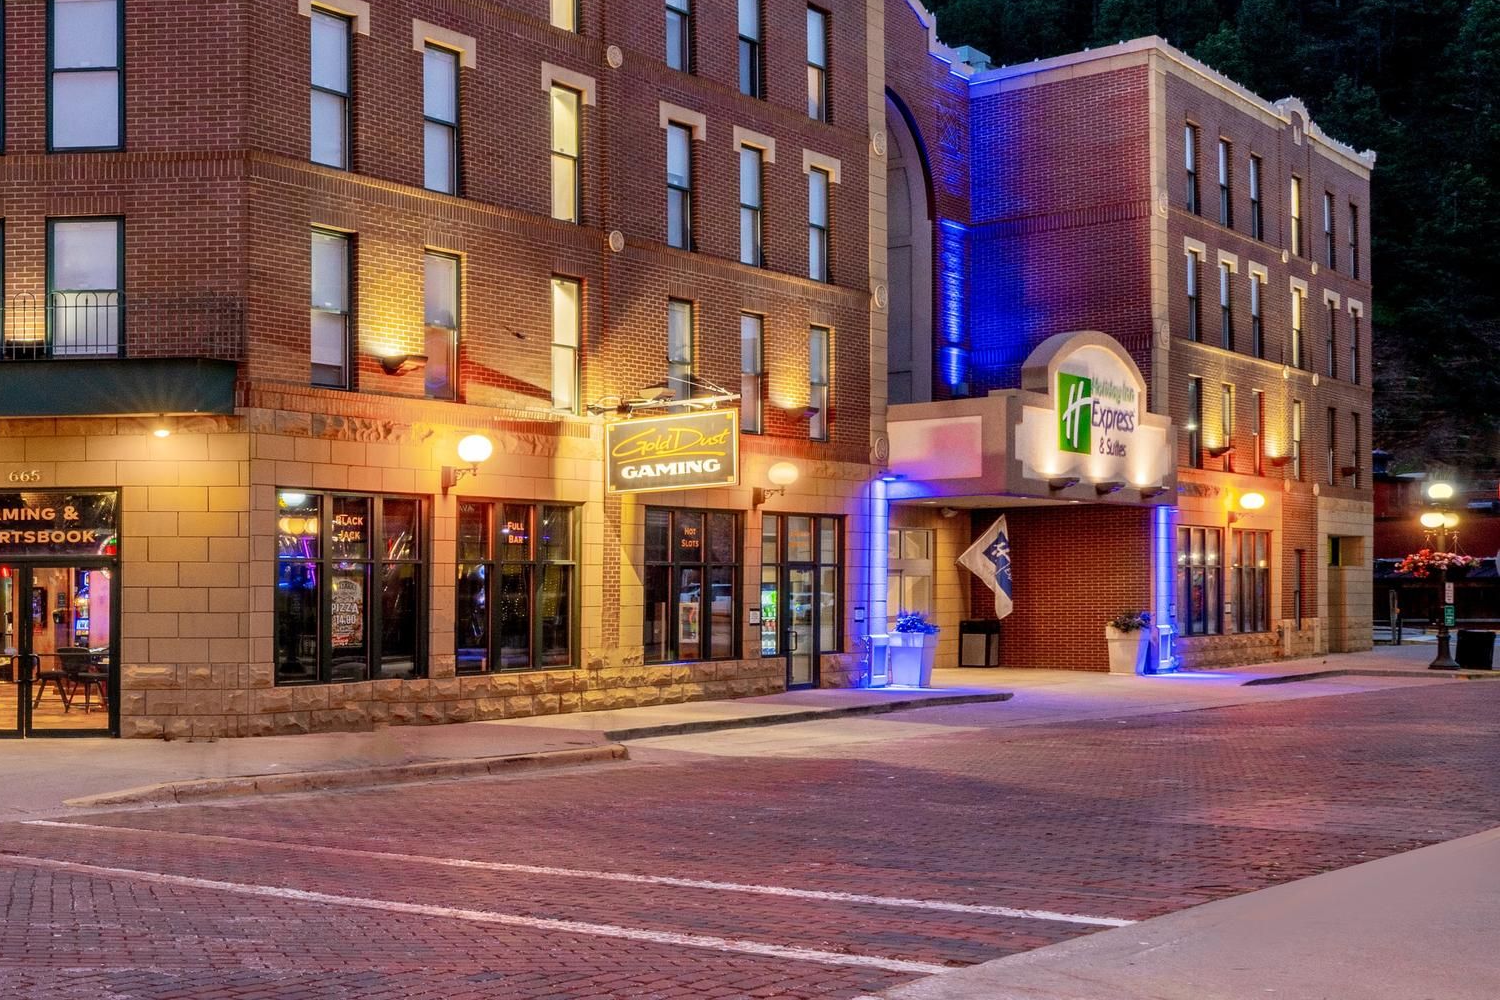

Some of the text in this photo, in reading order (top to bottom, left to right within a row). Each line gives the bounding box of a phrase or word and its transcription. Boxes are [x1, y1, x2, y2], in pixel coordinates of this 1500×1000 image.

[1091, 376, 1135, 404] Holiday Inn
[1092, 399, 1135, 436] Express
[612, 427, 730, 457] Gold Dust
[1099, 437, 1126, 457] & Suites
[621, 458, 721, 479] GAMING
[8, 470, 41, 482] 665
[63, 505, 79, 520] &
[507, 521, 524, 531] FULL
[684, 527, 697, 536] HOT
[508, 534, 524, 543] BAR
[681, 539, 699, 548] SLOTS
[332, 603, 359, 614] PIZZA
